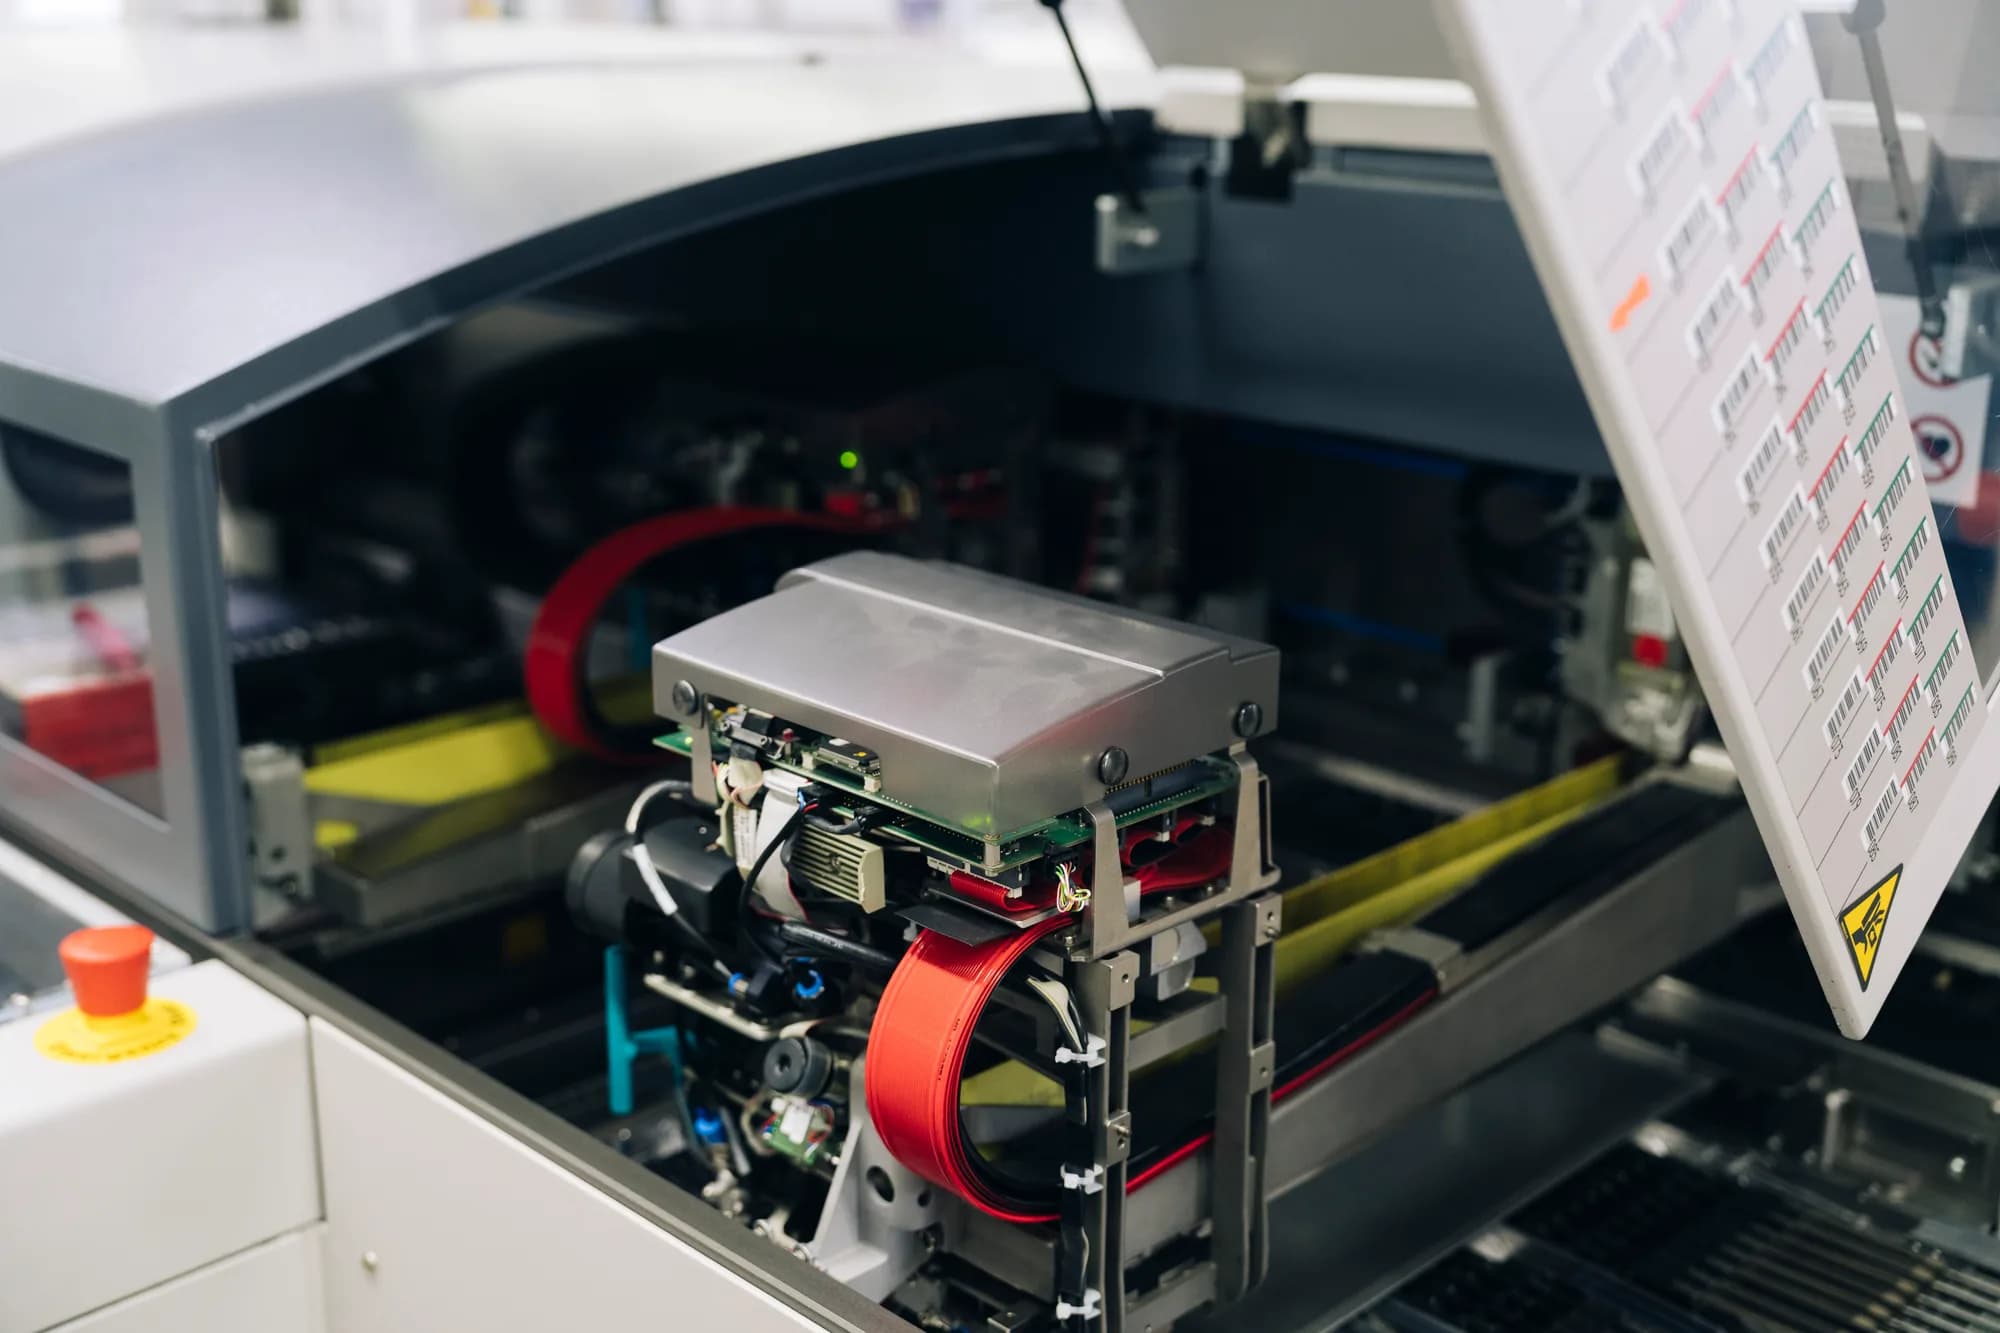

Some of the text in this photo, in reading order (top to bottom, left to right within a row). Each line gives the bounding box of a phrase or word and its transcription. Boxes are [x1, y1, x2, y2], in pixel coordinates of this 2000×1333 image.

[1880, 526, 1893, 551] 065
[1837, 571, 1849, 598] 063
[1898, 585, 1909, 609] 071
[1856, 629, 1868, 655] 069
[1914, 640, 1926, 664] 077
[1873, 686, 1885, 711] 075
[1930, 694, 1942, 718] 083
[1831, 734, 1843, 759] 073
[1891, 740, 1902, 764] 081
[1850, 787, 1862, 812] 079
[1908, 791, 1919, 813] 087
[1868, 838, 1879, 862] 085
